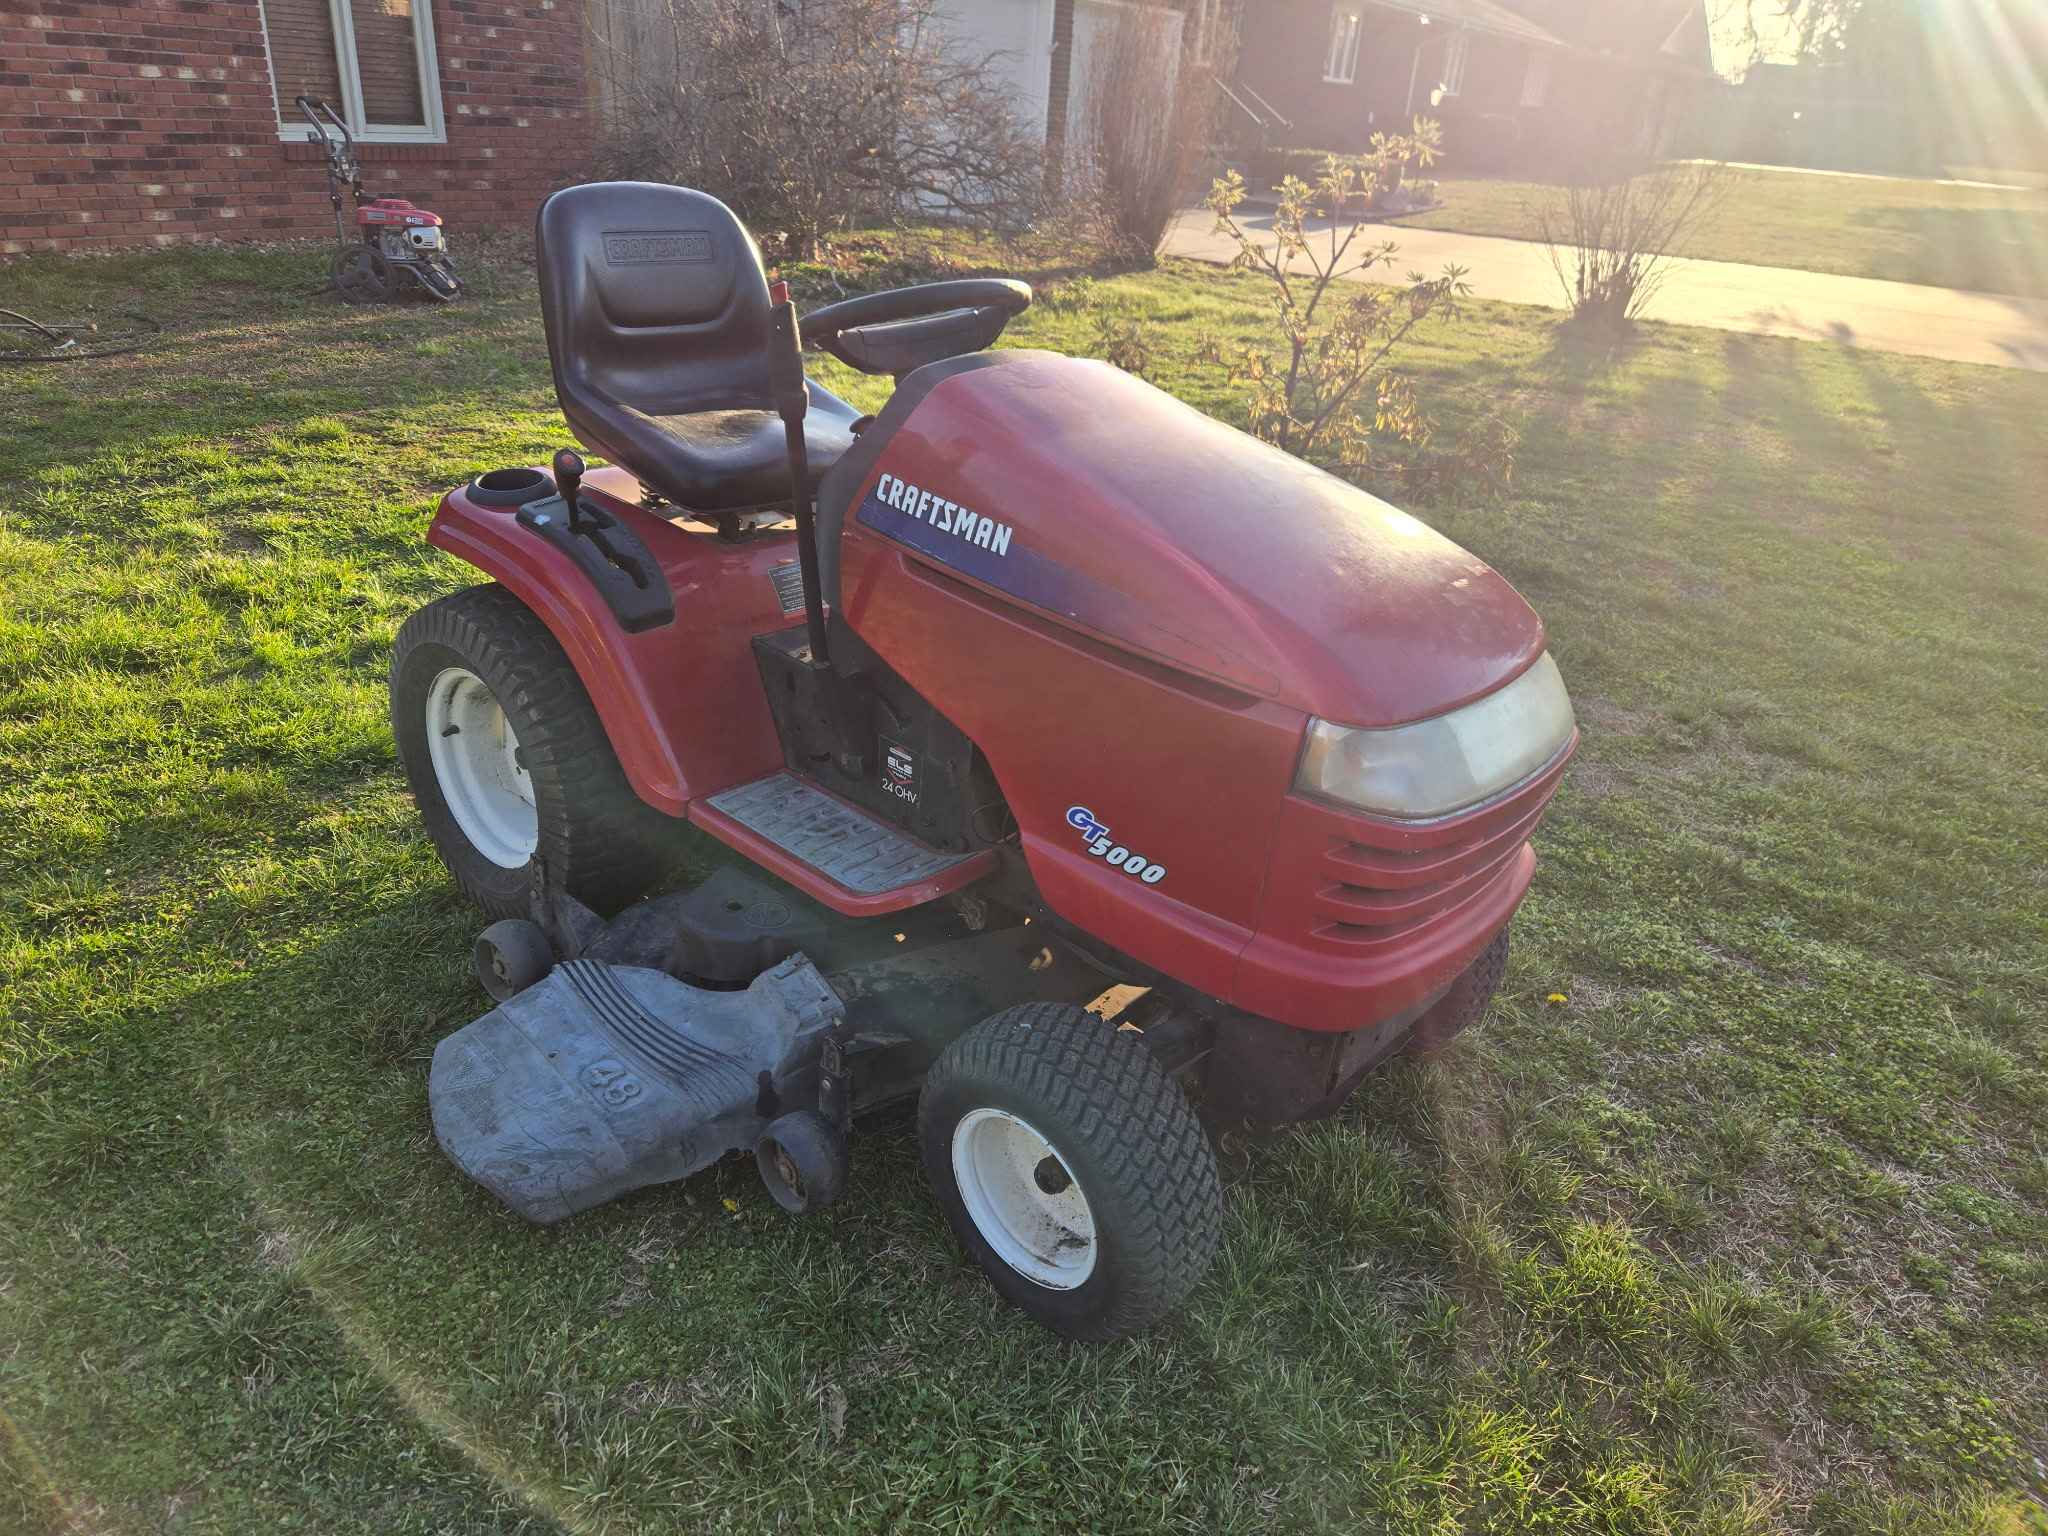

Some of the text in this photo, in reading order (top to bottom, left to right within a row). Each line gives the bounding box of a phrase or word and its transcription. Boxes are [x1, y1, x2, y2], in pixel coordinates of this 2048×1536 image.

[876, 473, 1013, 557] CRAFTSMAN
[882, 778, 917, 803] 24 OHV
[1066, 806, 1166, 883] GT 5000
[589, 1062, 641, 1105] 48
